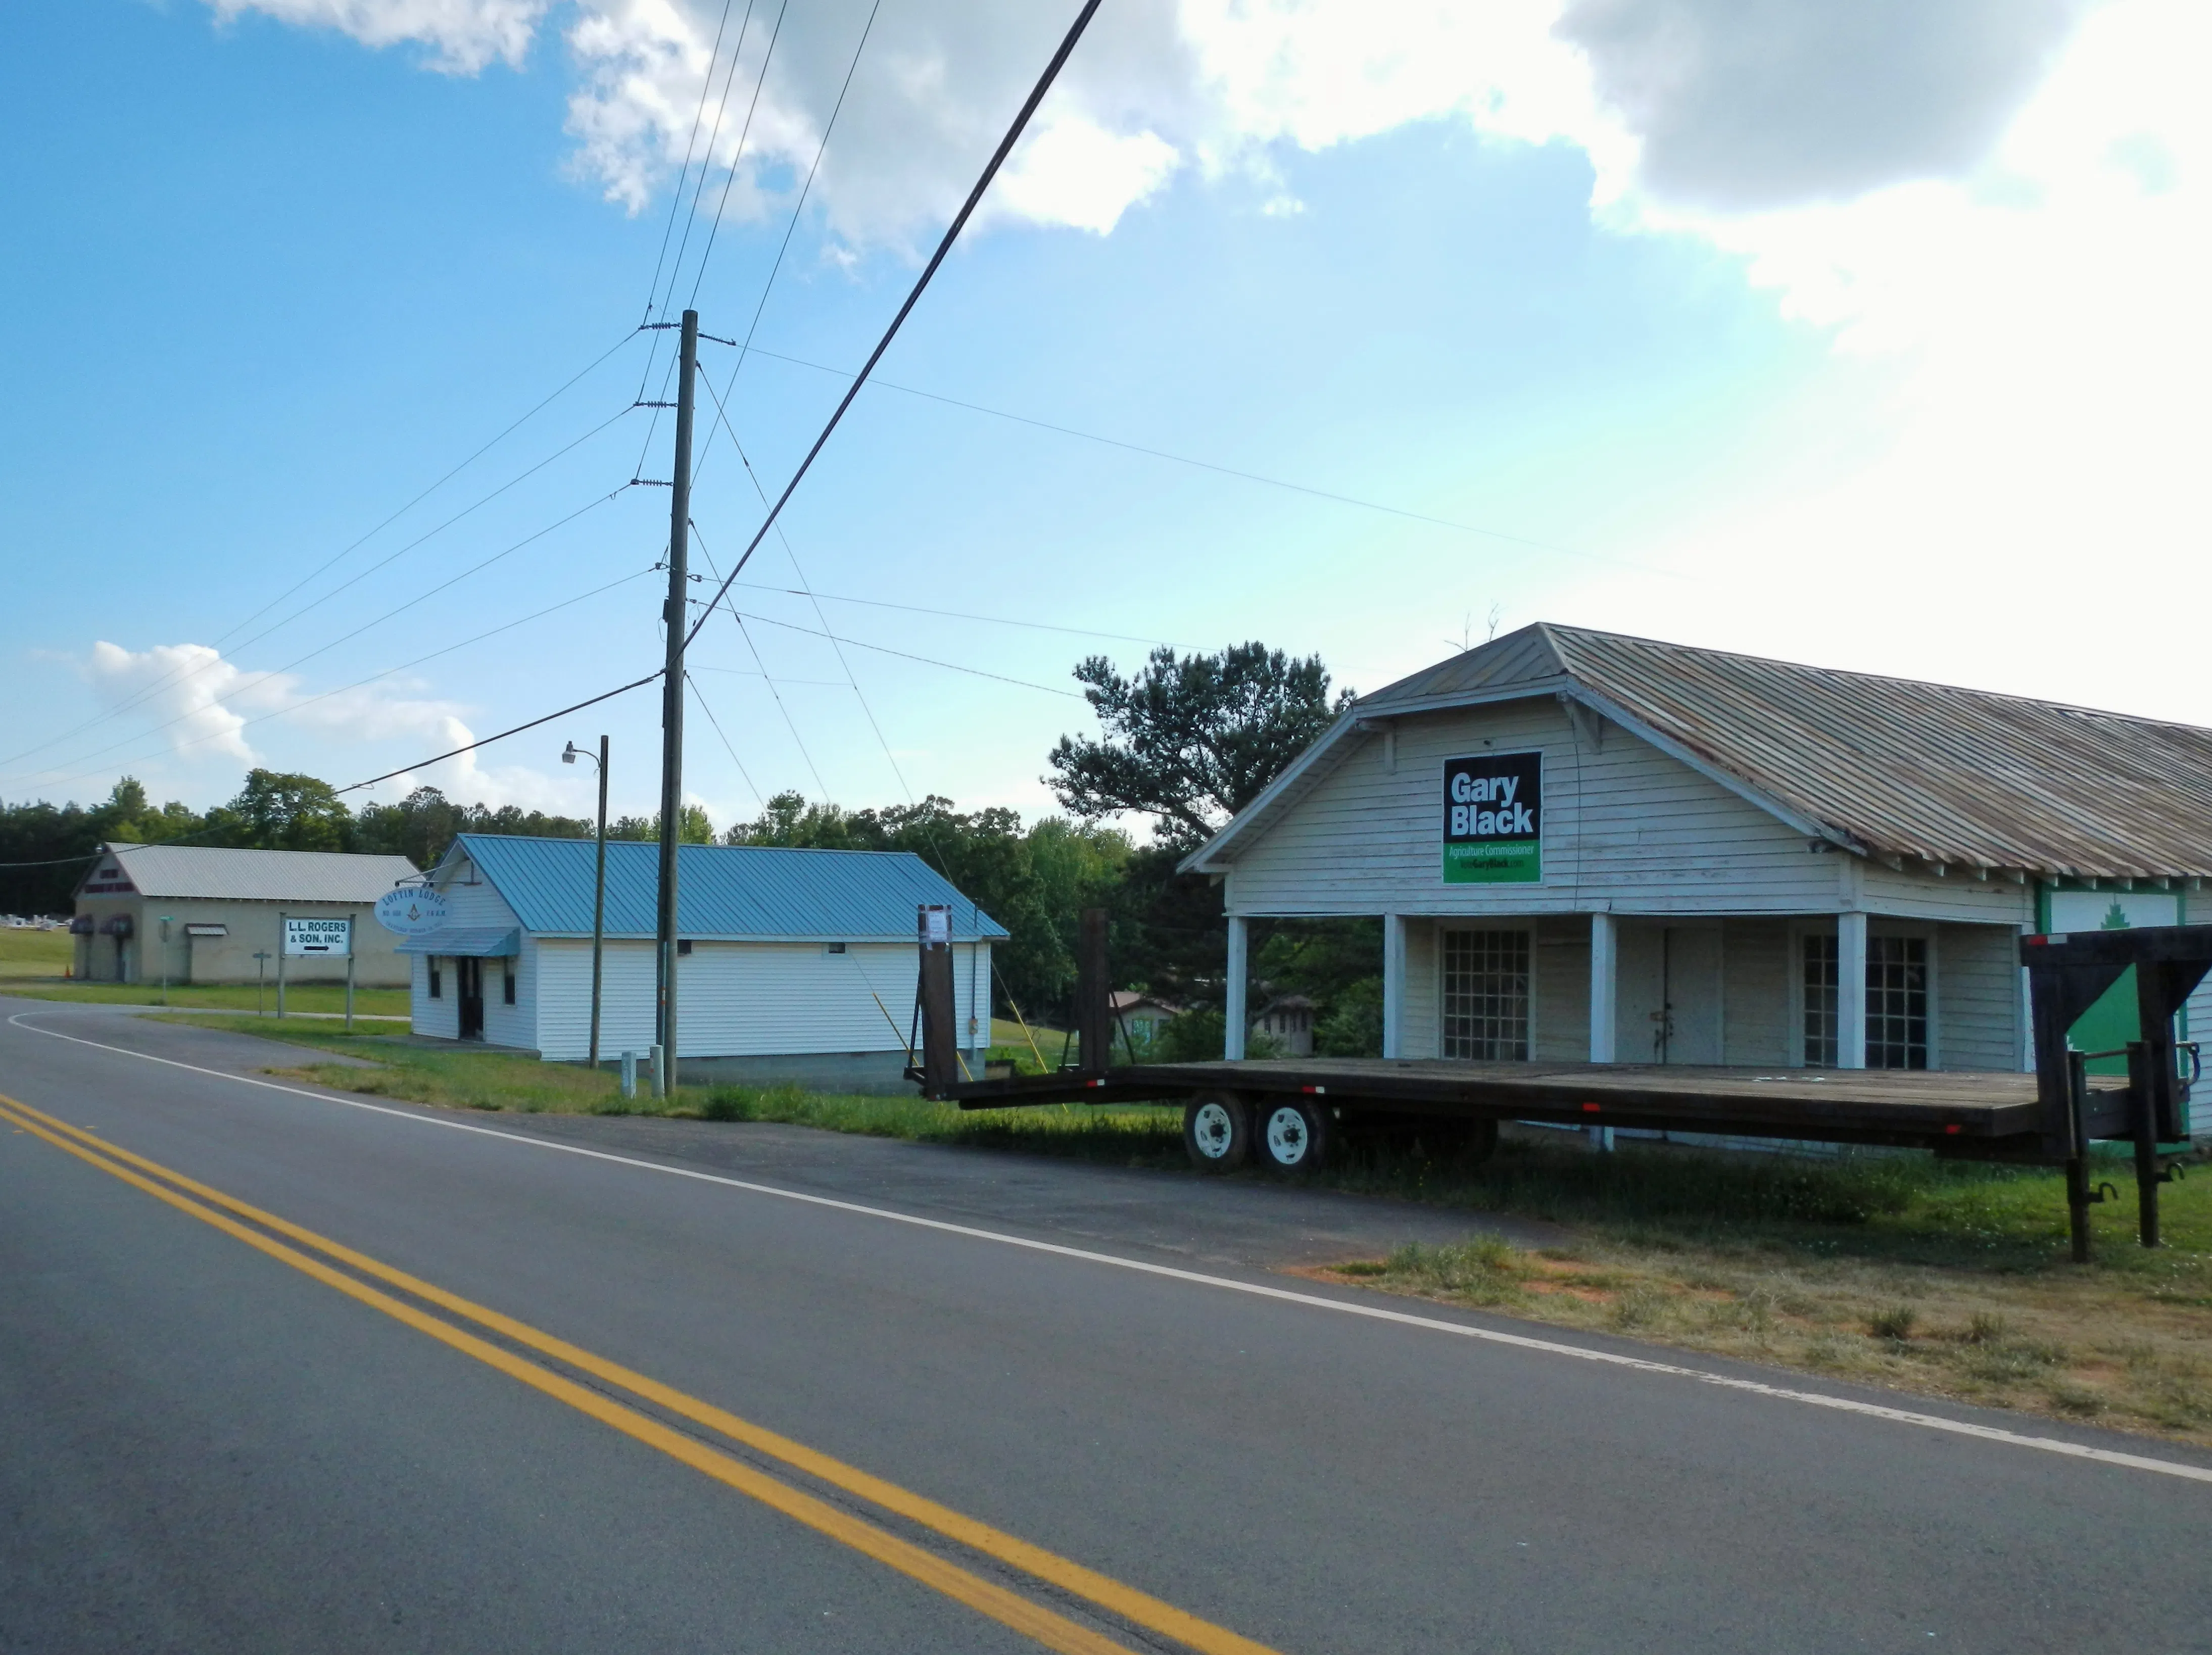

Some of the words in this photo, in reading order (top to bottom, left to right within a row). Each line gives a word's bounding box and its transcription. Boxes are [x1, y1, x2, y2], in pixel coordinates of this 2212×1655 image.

[1451, 772, 1519, 808] Gary
[1451, 802, 1534, 836] Black
[1449, 846, 1484, 859] Agriculture
[1485, 844, 1534, 856] Commissioner
[382, 889, 414, 906] LOFTIN
[418, 889, 446, 906] LODGE
[308, 921, 346, 933] ROGERS
[290, 935, 297, 943] &
[299, 934, 322, 944] SON,
[324, 934, 344, 944] INC.
